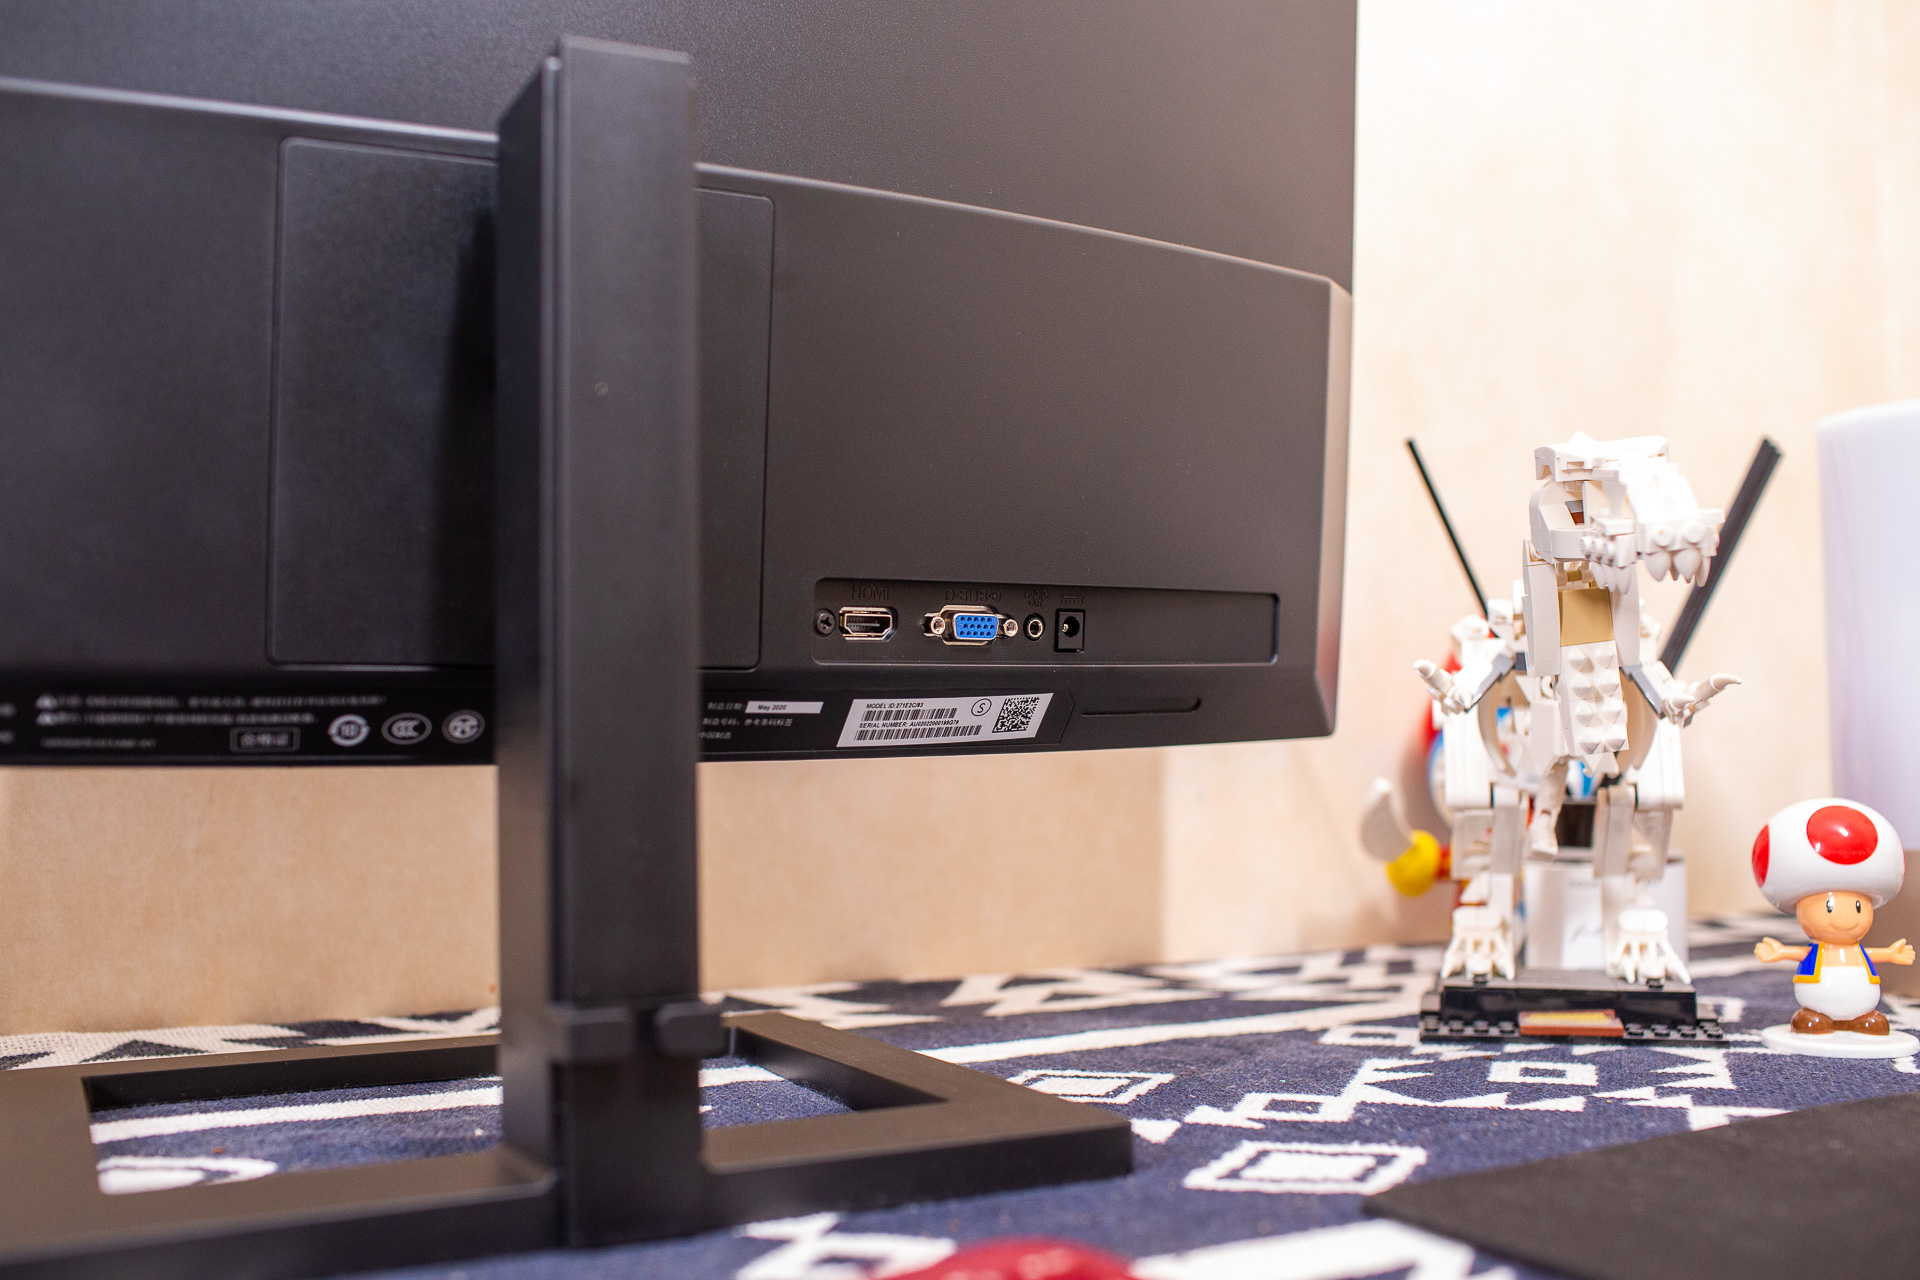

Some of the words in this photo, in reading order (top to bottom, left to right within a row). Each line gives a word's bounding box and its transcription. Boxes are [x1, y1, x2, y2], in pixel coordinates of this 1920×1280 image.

[851, 585, 890, 601] HDMI
[1024, 589, 1049, 599] AUDIO
[1028, 598, 1044, 607] OUT
[758, 704, 771, 712] May
